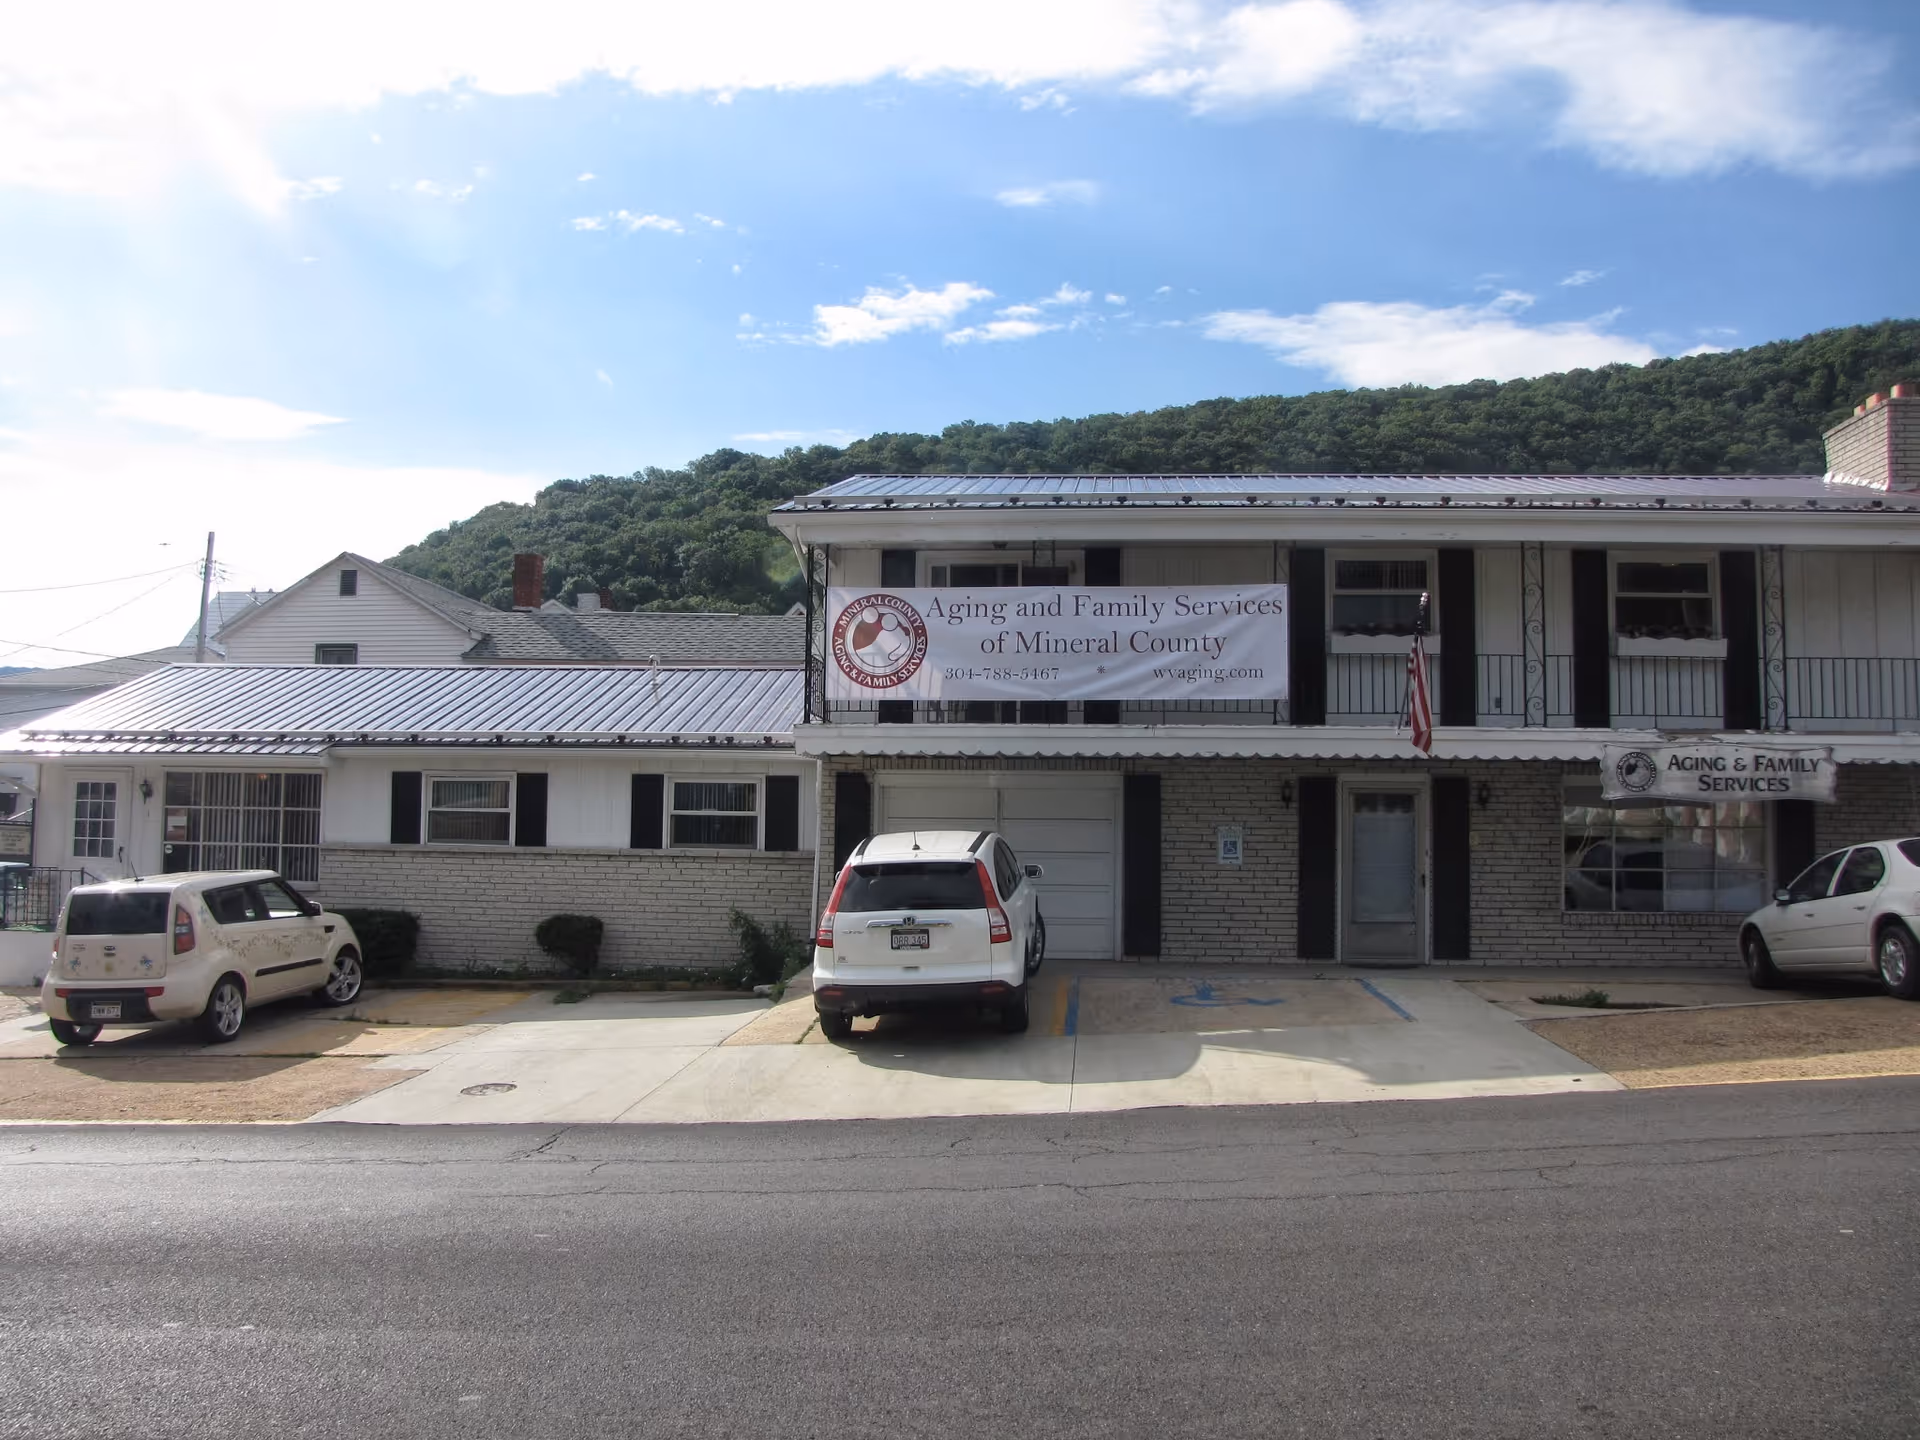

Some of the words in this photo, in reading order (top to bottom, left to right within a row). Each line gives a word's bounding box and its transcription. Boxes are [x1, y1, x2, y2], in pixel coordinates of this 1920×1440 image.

[840, 596, 884, 628] MINERAL
[884, 597, 922, 627] COUNTY
[926, 596, 1008, 625] Aging
[1016, 595, 1061, 617] and
[1073, 595, 1165, 624] Family
[1175, 593, 1283, 616] Services
[981, 631, 1009, 654] of
[1015, 631, 1120, 654] Mineral
[1129, 630, 1227, 660] County
[834, 636, 854, 672] AGING
[850, 669, 859, 679] &
[859, 673, 899, 687] FAMILY
[898, 636, 926, 680] SERVICES
[945, 667, 1060, 681] 304-788-5467
[1153, 664, 1264, 684] wvaging.com
[1667, 754, 1726, 772] AGING
[1733, 757, 1747, 772] &
[1754, 755, 1821, 773] FAMILY
[1699, 774, 1790, 792] SERVICES
